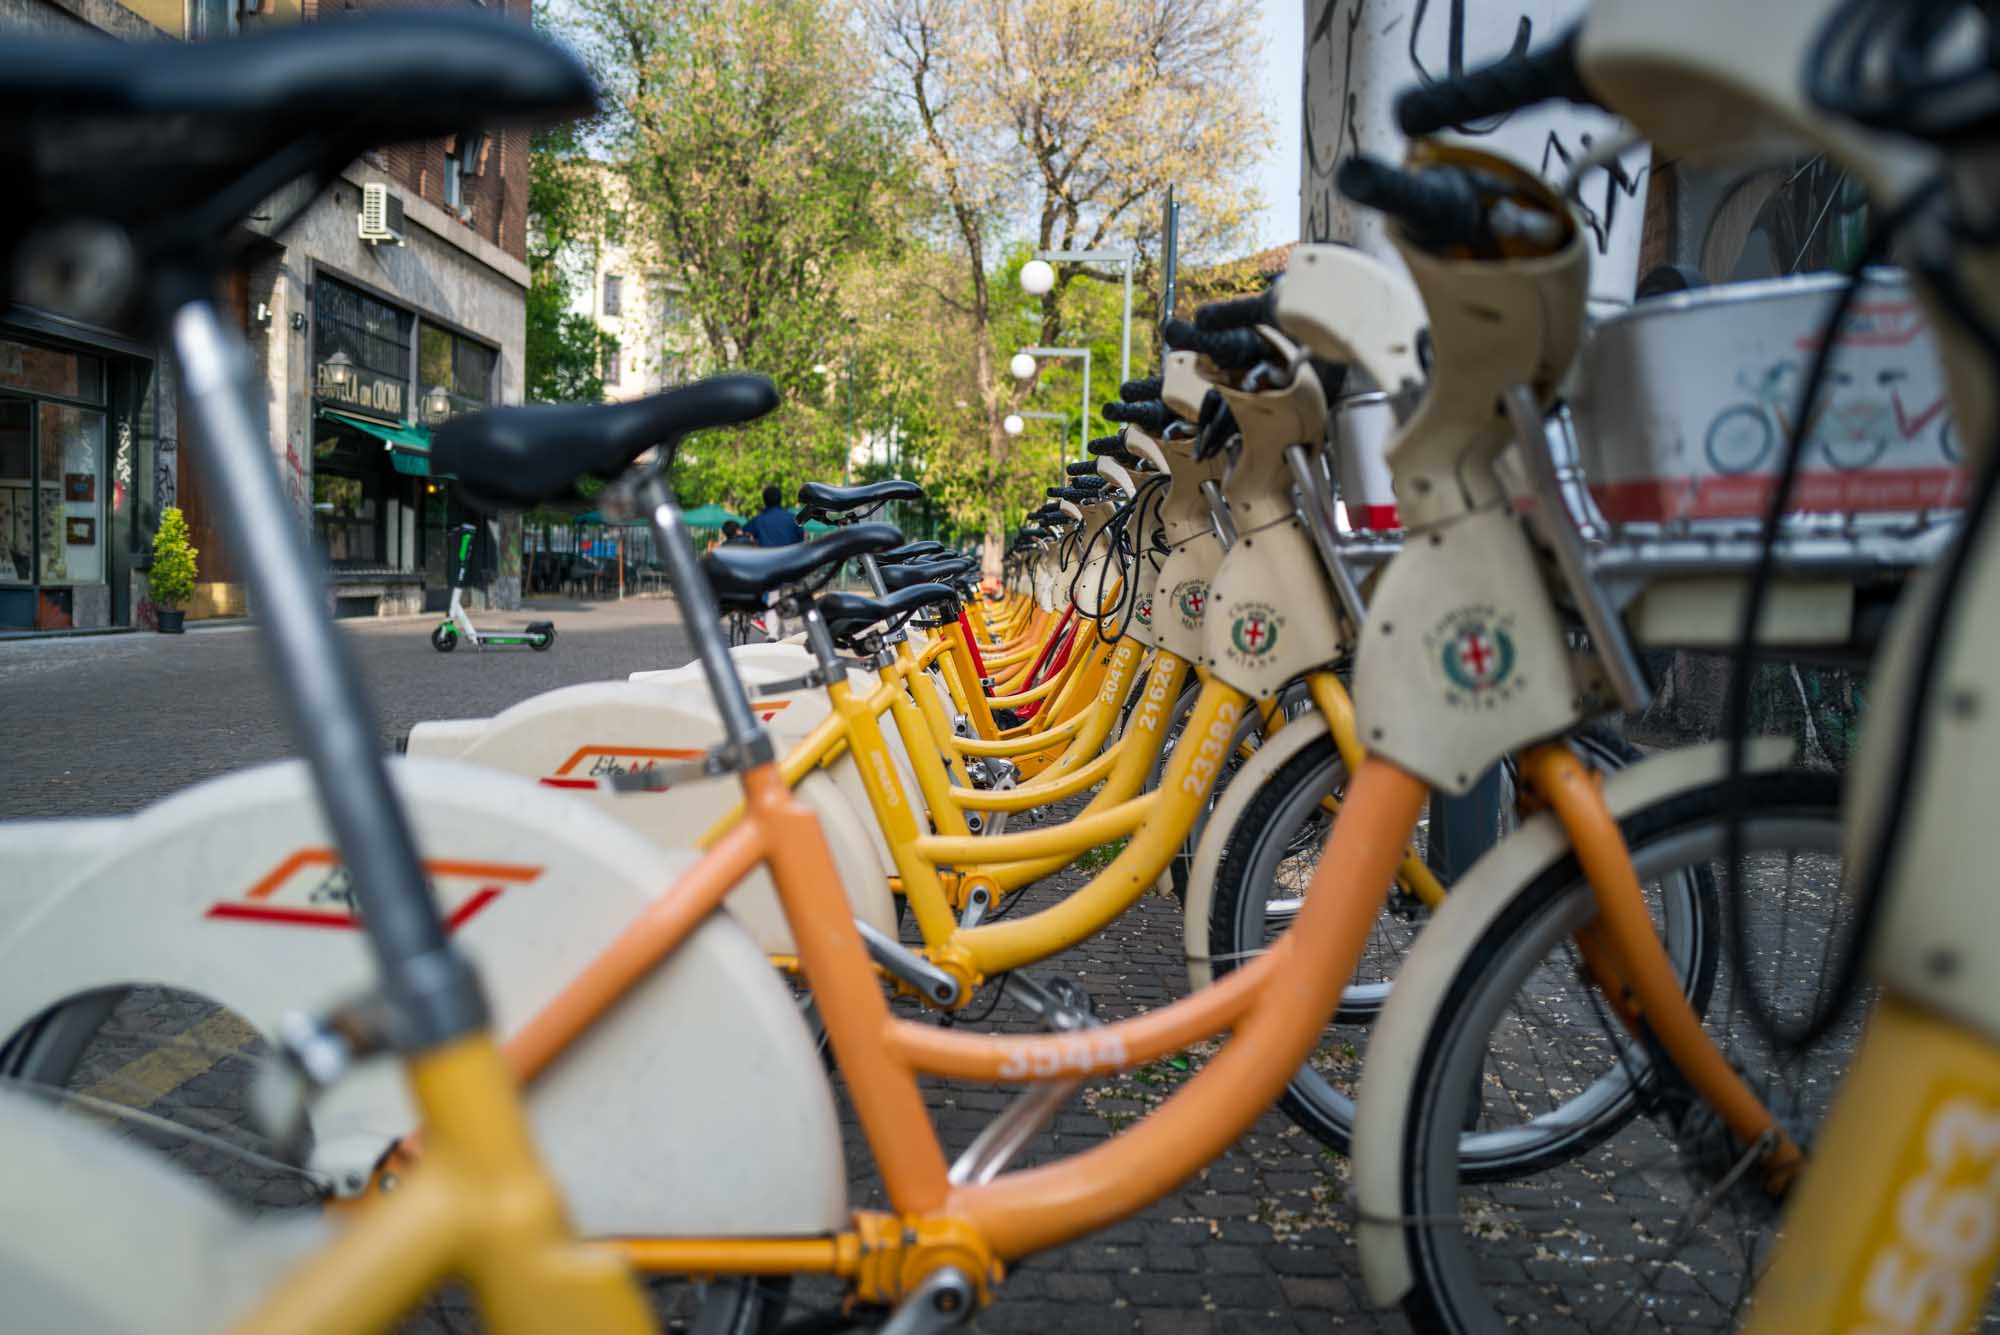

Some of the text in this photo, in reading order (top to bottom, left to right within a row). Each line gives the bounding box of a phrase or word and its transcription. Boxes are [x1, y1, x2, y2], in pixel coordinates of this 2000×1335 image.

[1101, 647, 1131, 704] 20475
[1138, 657, 1177, 732] 21626
[1183, 702, 1242, 798] 23382
[1846, 1093, 2000, 1335] 563
